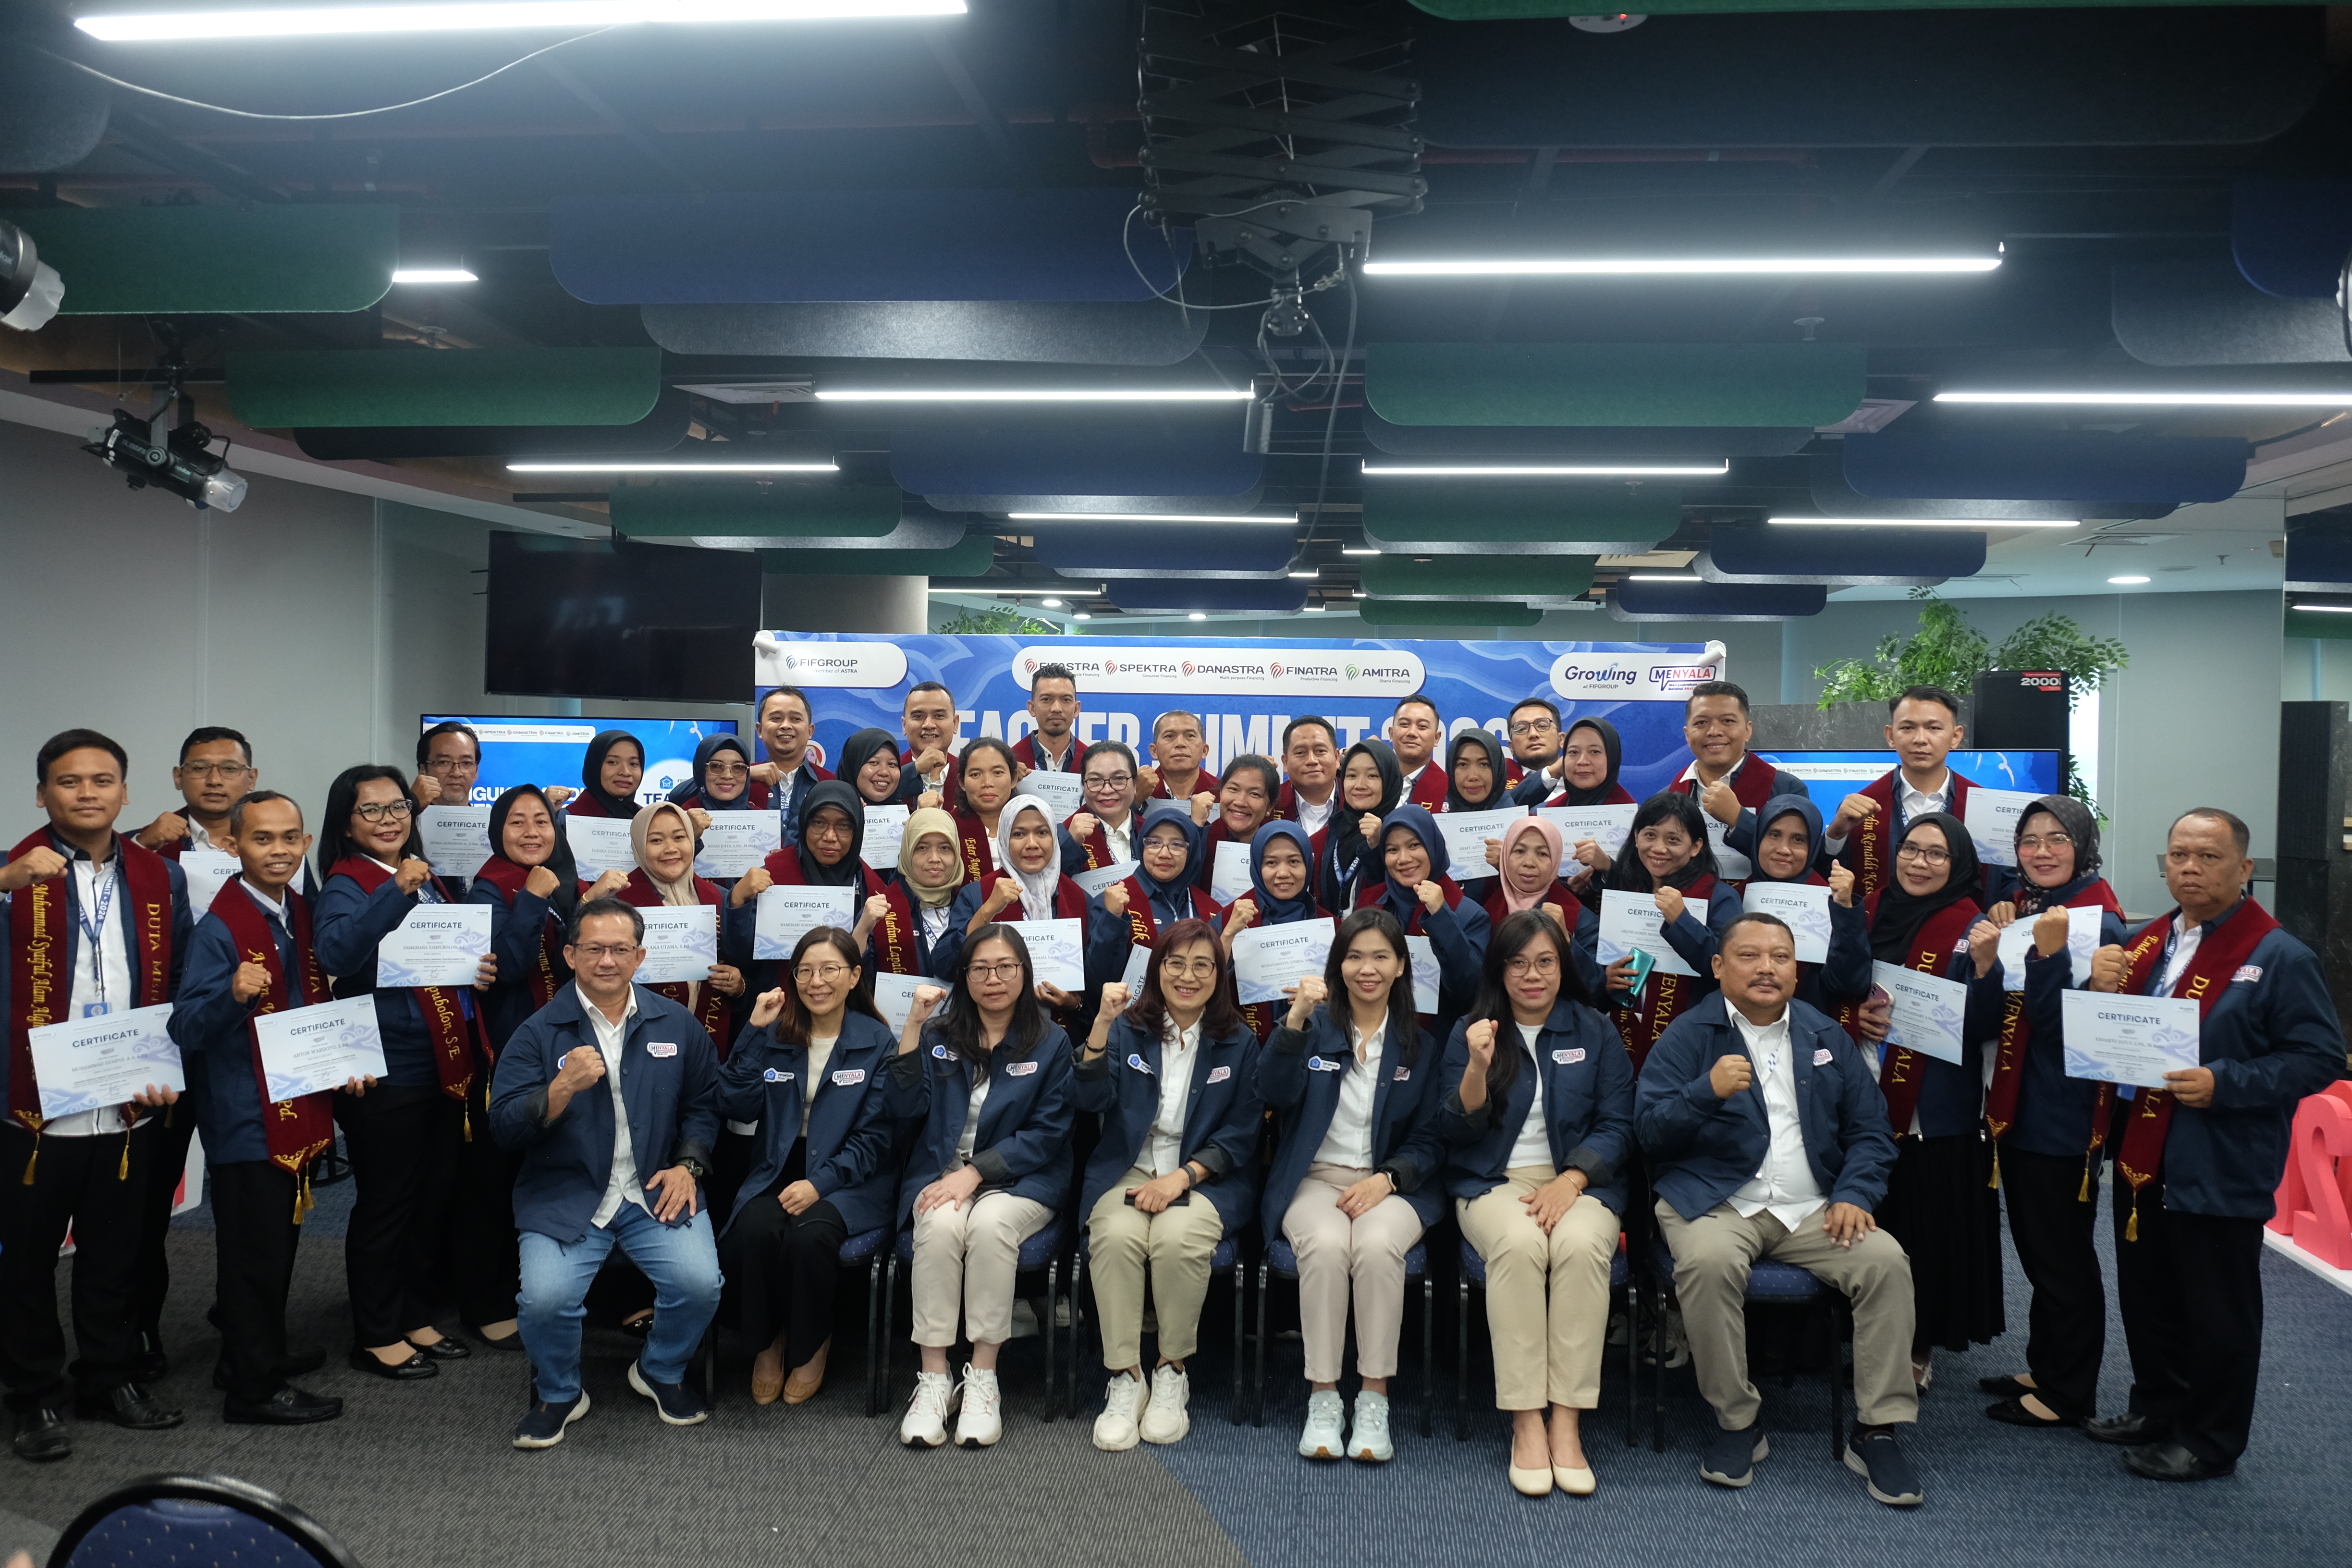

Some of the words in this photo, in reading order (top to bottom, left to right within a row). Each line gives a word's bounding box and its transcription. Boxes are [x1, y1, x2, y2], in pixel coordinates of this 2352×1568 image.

[800, 659, 858, 667] FIFGROUP
[1119, 664, 1176, 673] SPEKTRA
[1198, 665, 1264, 674] DANASTRA
[1286, 667, 1337, 675] FINATRA
[1362, 668, 1410, 677] AMITRA
[1565, 664, 1637, 685] Growing
[1655, 668, 1711, 682] MENYALA
[1038, 784, 1079, 793] CERTIFICATE
[1459, 823, 1504, 833] CERTIFICATE
[1861, 833, 1879, 870] Renaldi
[1092, 879, 1123, 891] CERTIFIC
[1760, 897, 1808, 907] CERTIFICATE
[32, 883, 53, 942] Muhammad
[1628, 908, 1664, 918] CERTIFIC
[147, 902, 161, 952] DUTA
[643, 922, 688, 930] ERTIFICATE
[1260, 936, 1309, 949] CERTIFICATE
[1895, 983, 1939, 1002] CERTIFICATE
[705, 996, 722, 1034] YALA
[2097, 1012, 2161, 1025] CERTIFICATE
[290, 1018, 346, 1036] CERTIFICATE
[72, 1029, 139, 1048] CERTIFICATE
[1210, 1068, 1226, 1077] NYALA
